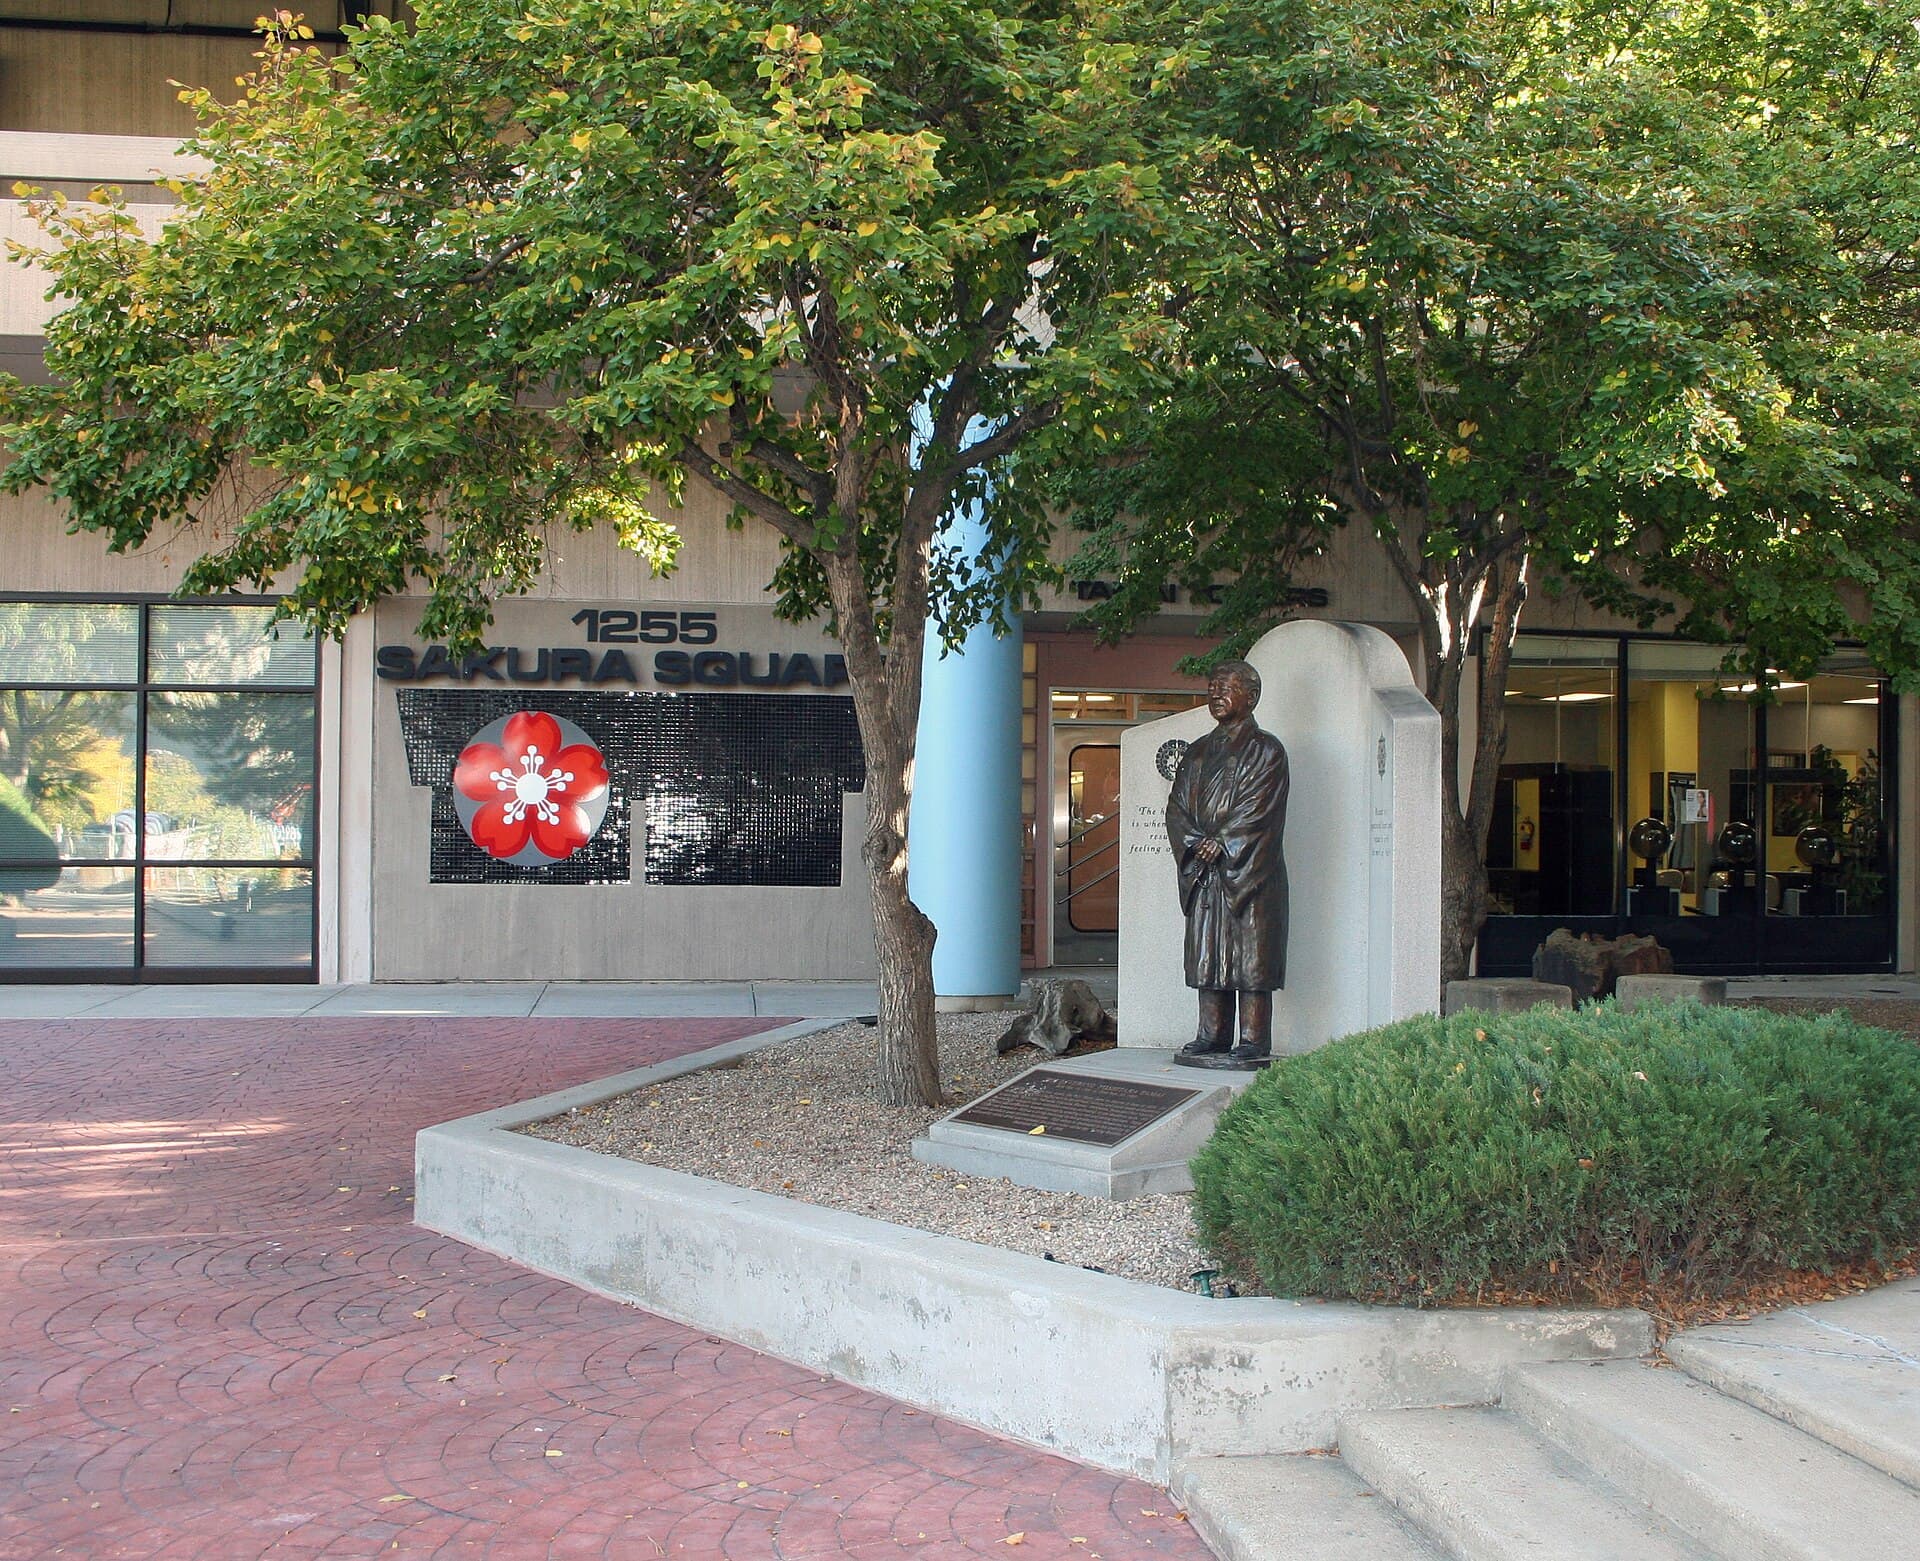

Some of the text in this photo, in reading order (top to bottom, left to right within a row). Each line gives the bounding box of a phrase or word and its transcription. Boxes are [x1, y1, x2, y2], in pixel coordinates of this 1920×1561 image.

[572, 608, 717, 645] 1255
[377, 645, 849, 687] SAKURA SQUAR
[1129, 844, 1161, 854] feeling
